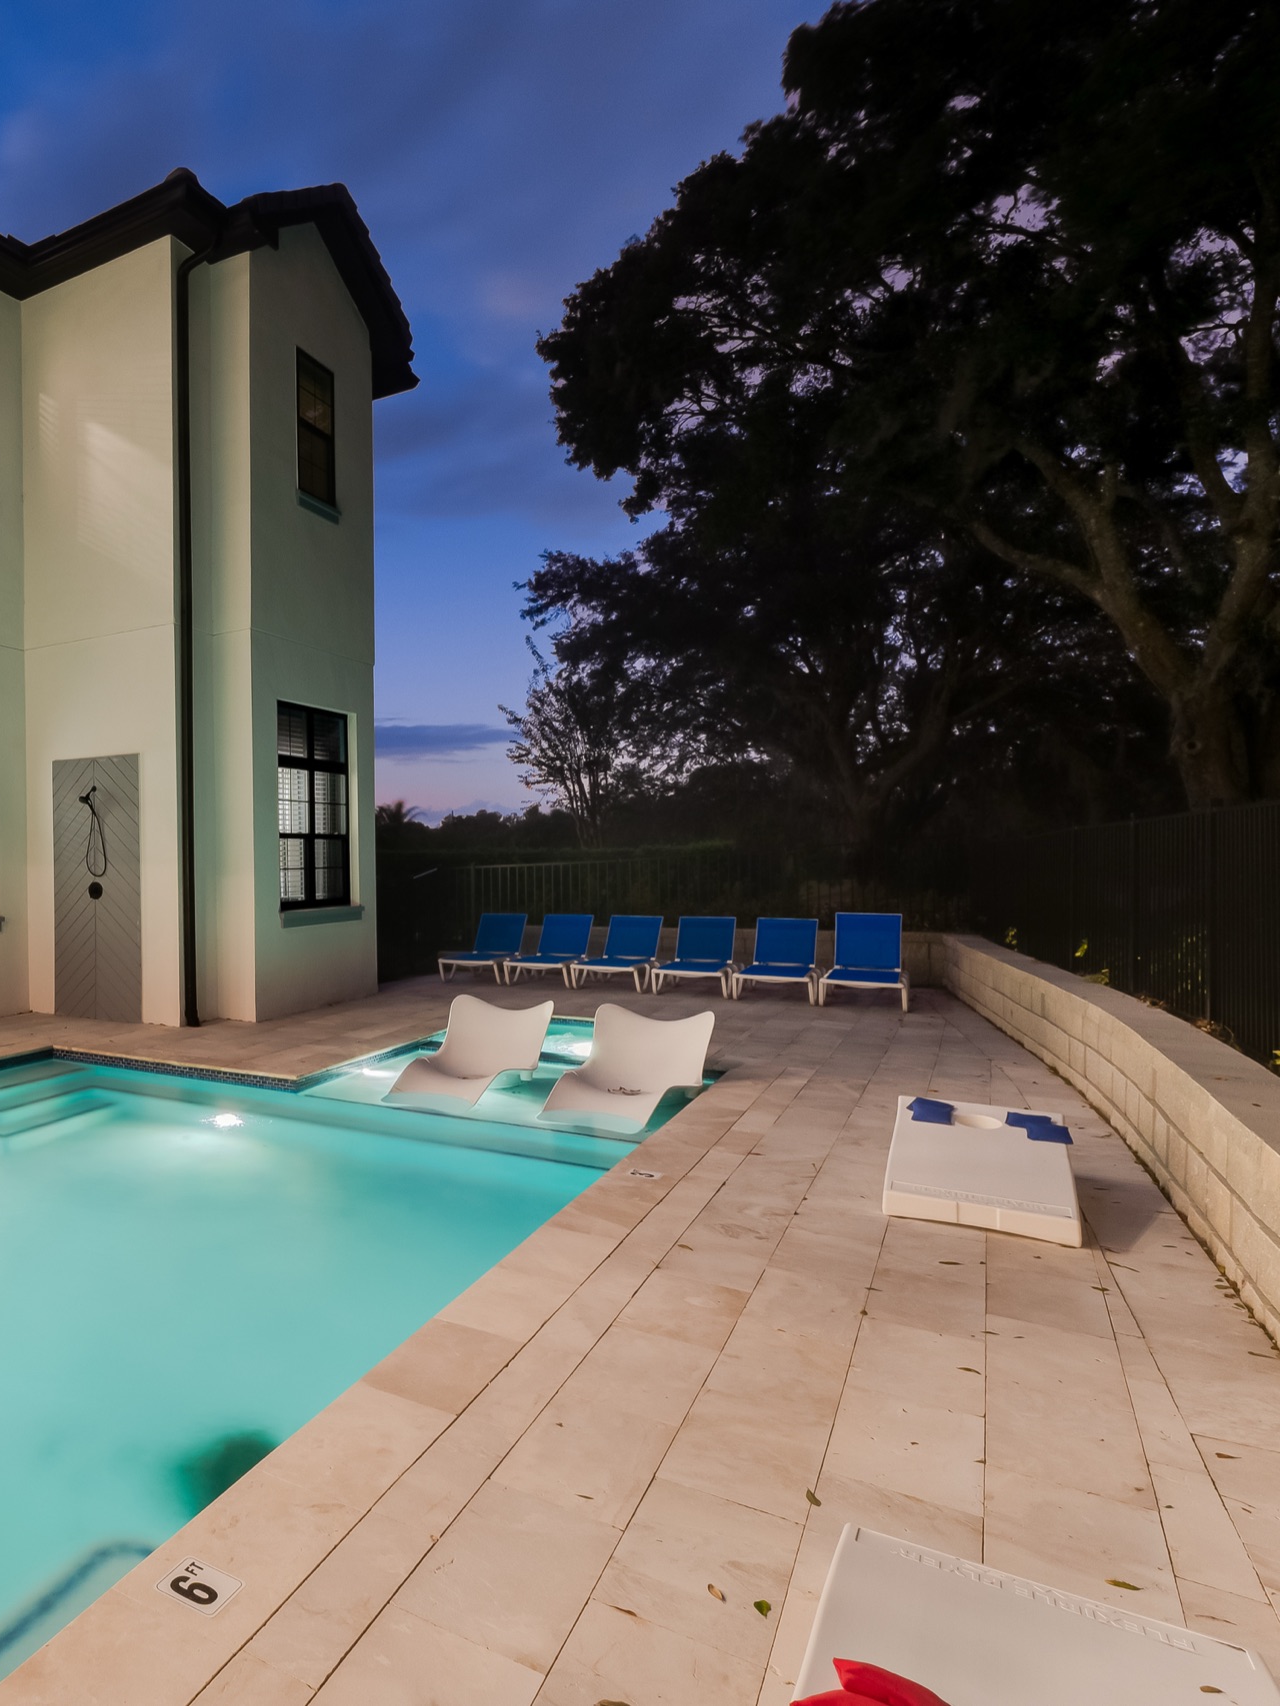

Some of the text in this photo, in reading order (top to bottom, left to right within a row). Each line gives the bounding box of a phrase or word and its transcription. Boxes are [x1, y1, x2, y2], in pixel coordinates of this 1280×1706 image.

[170, 1561, 219, 1606] 6 FT
[898, 1547, 1197, 1651] FLEXIBLE FLYER
